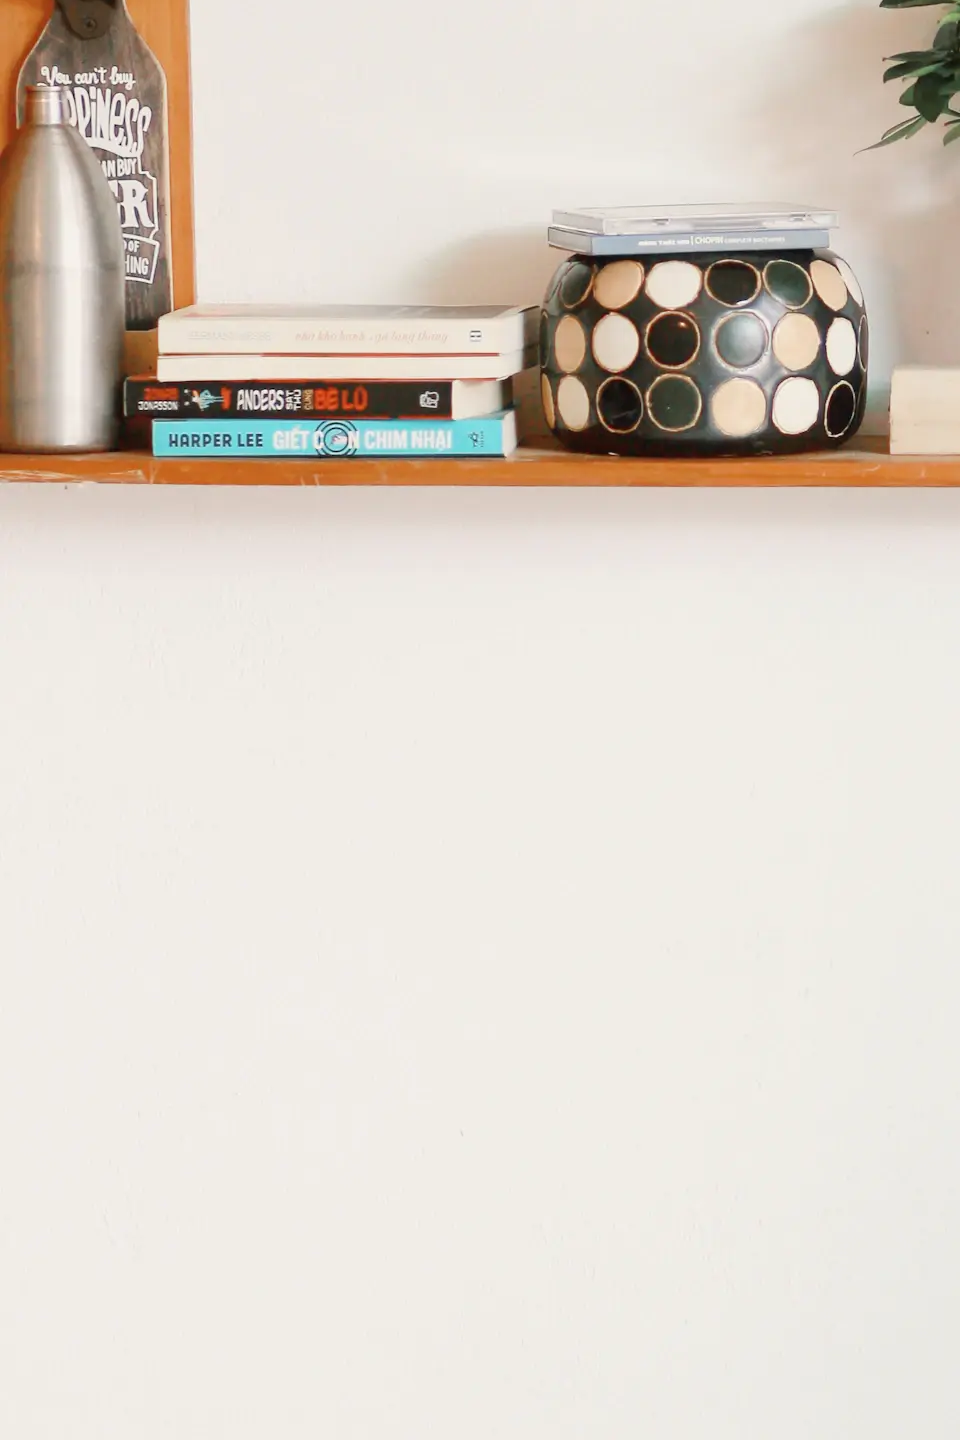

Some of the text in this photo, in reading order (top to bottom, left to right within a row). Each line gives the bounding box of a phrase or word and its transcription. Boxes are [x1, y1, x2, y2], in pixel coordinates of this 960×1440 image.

[37, 65, 136, 90] You can't buy
[117, 158, 137, 177] BUY
[128, 240, 140, 253] OF
[138, 401, 178, 411] JONASSON
[236, 389, 285, 411] ANDERS
[169, 433, 232, 448] HARPER
[237, 433, 263, 448] LEE
[364, 430, 410, 450] CHIM
